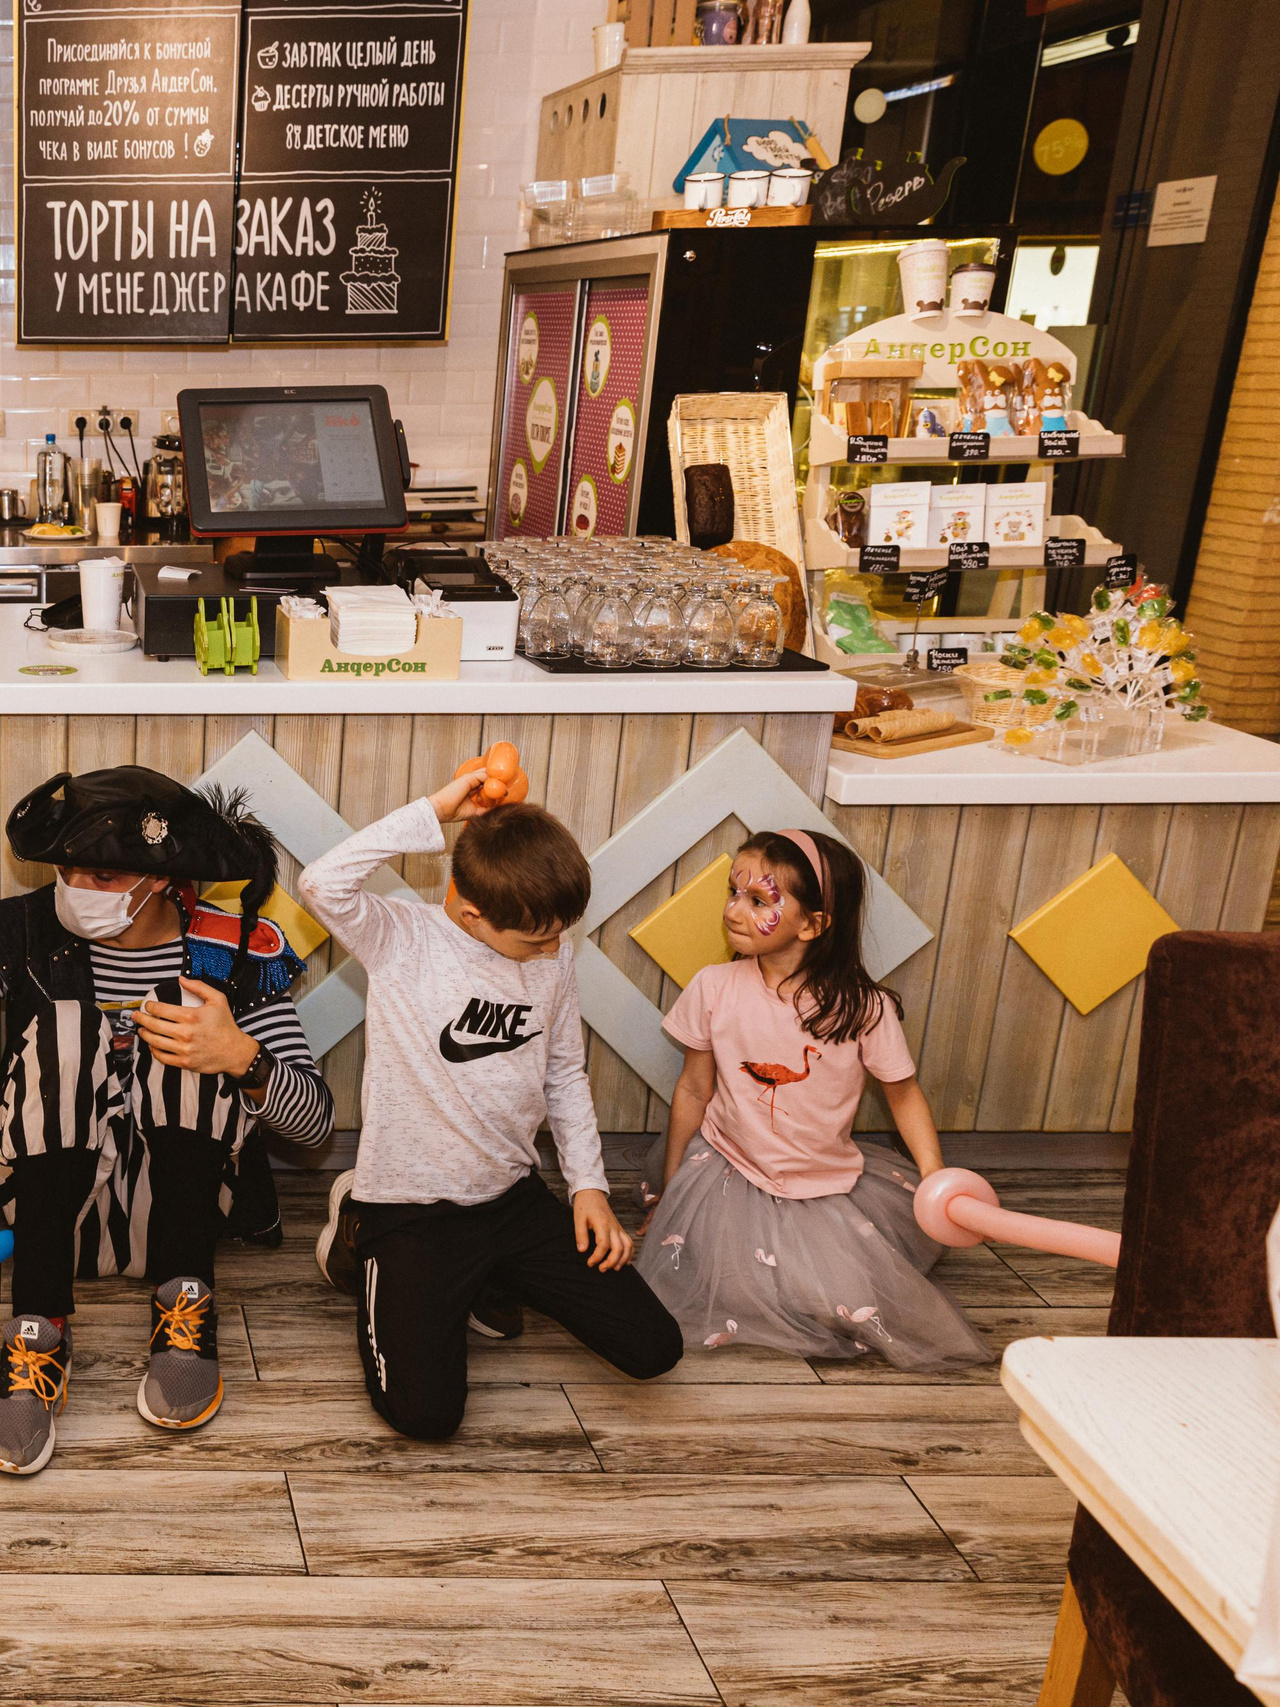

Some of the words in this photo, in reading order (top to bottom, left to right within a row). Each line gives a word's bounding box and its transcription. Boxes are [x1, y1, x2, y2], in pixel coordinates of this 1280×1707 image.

[282, 42, 343, 68] ЗАВТРАК
[345, 36, 397, 70] ЦЕЛЫЙ
[401, 39, 437, 68] ДЕНЬ
[272, 84, 334, 111] ДЕСЕРТЫ
[337, 78, 390, 108] РУЧНОЙ
[392, 82, 445, 108] РАБОТЫ
[103, 99, 140, 127] 20%
[303, 124, 365, 150] ДЕТСКОЕ
[369, 124, 410, 150] МЕНЮ
[46, 199, 155, 263] ТОРТЫ
[168, 199, 217, 259] НА
[234, 196, 337, 258] ЗАКАЗ
[54, 271, 68, 313] У
[863, 335, 1032, 365] АндерСон
[320, 658, 427, 677] АндерСон
[453, 997, 534, 1041] NIKE
